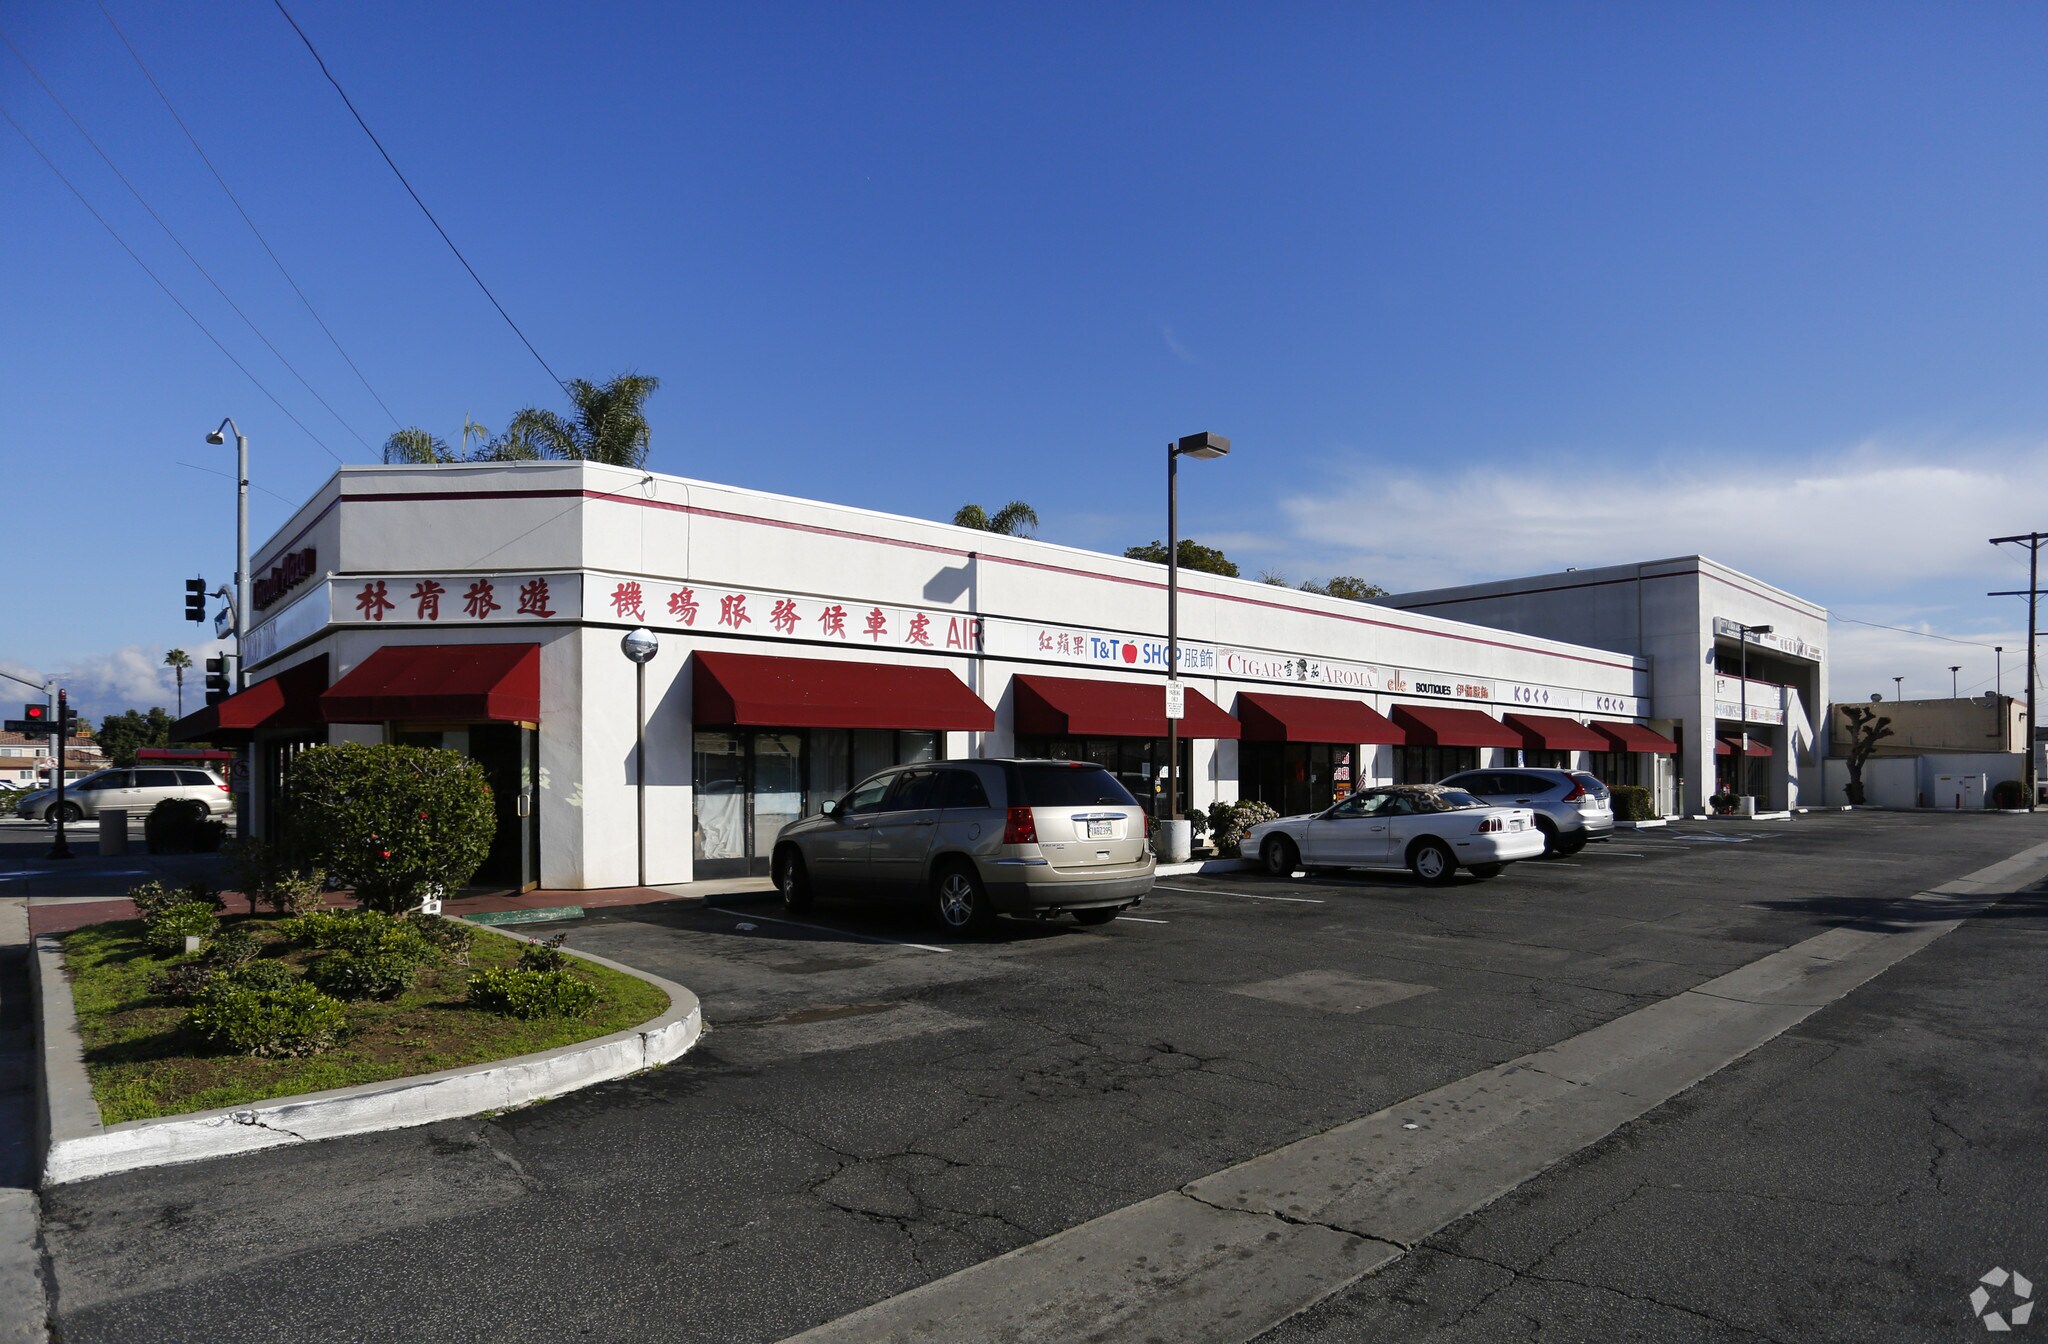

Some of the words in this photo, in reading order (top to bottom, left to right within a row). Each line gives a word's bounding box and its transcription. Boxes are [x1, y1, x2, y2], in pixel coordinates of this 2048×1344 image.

[356, 577, 556, 621] 林肯旅遊
[946, 616, 983, 651] AIR
[1038, 630, 1084, 656] 紅蘋果
[1091, 637, 1120, 661] T&T
[1184, 648, 1213, 669] 服飾
[1416, 682, 1451, 696] BOUTIQUES
